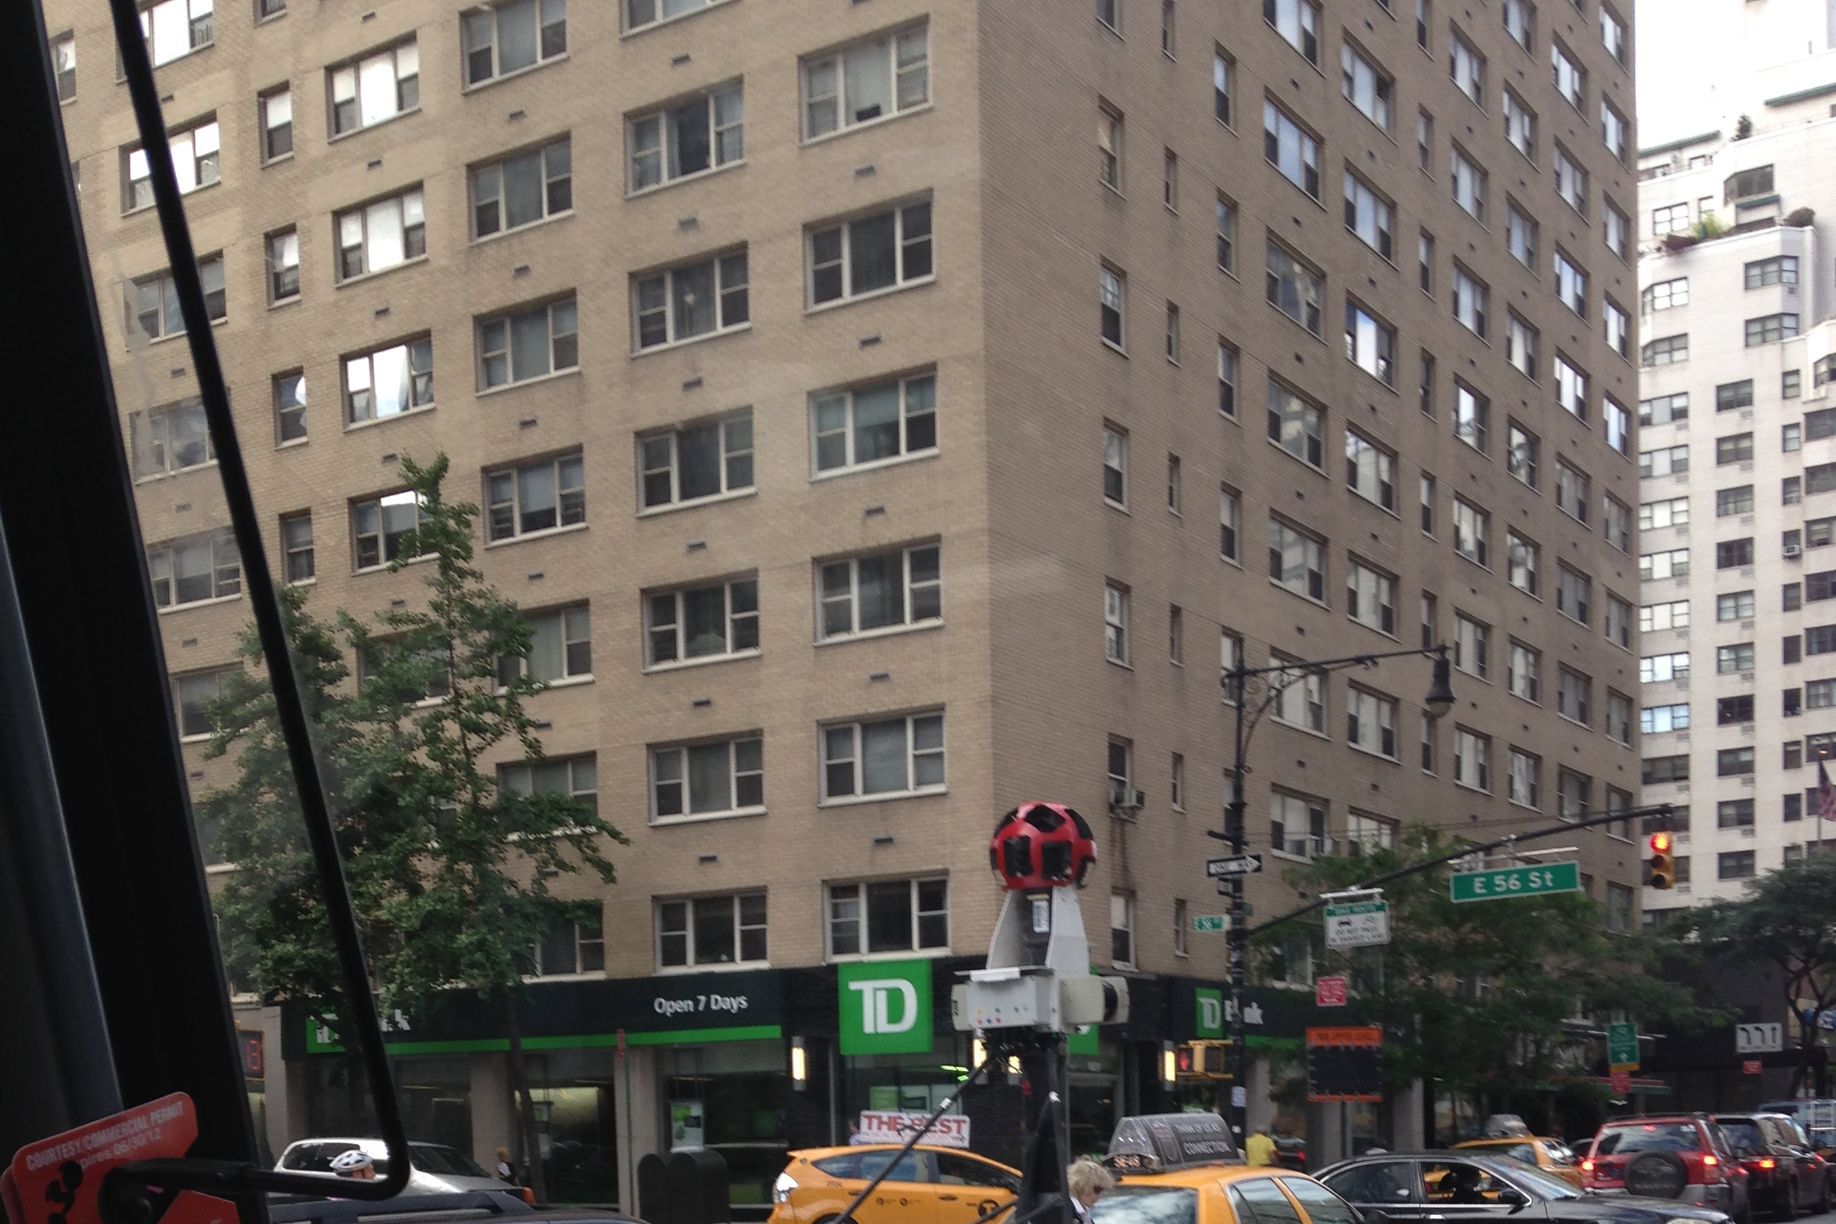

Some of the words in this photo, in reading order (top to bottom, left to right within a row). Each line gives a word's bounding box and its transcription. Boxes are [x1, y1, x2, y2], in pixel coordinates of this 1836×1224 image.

[1474, 877, 1487, 894] E
[1494, 873, 1521, 892] 56
[1528, 871, 1554, 888] St
[654, 997, 694, 1017] Open
[696, 995, 706, 1012] 7
[710, 994, 749, 1014] Days
[848, 978, 918, 1034] TD
[1198, 997, 1222, 1029] TD
[150, 1101, 184, 1125] PERMIT
[863, 1114, 905, 1132] THE
